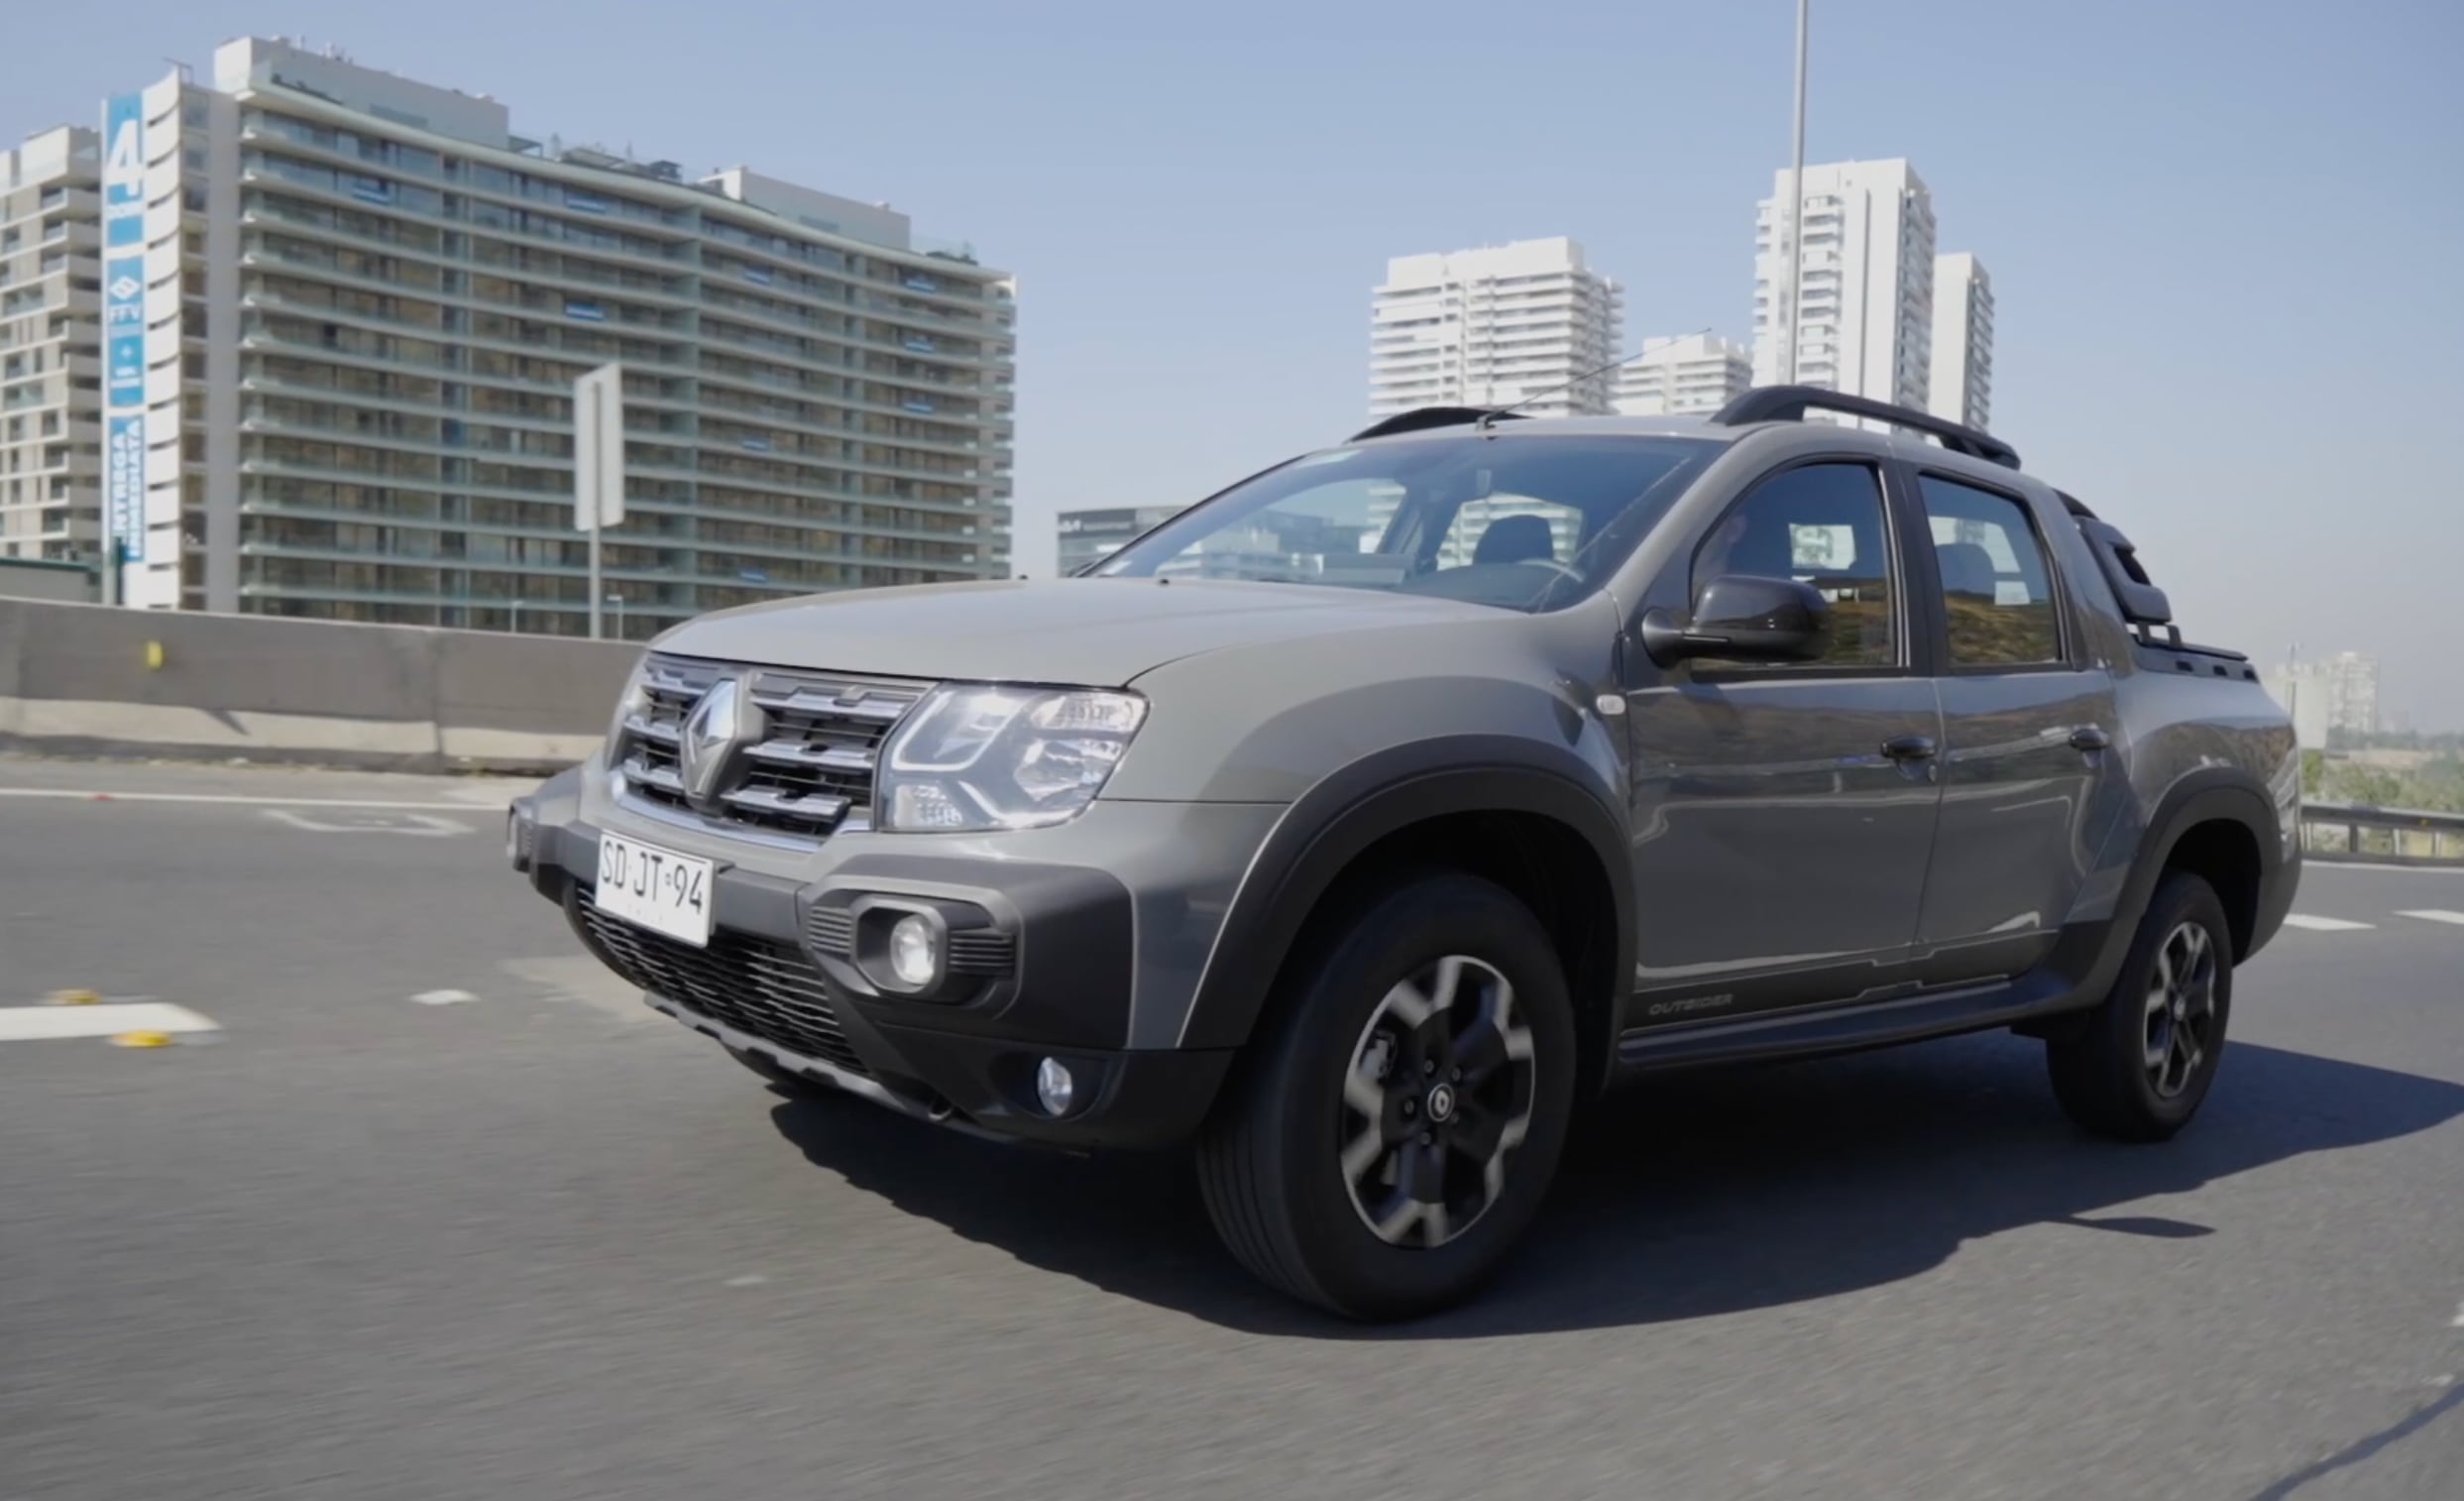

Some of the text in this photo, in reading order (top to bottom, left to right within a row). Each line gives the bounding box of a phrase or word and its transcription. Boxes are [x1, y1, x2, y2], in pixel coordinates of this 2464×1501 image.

[105, 119, 143, 196] 4
[127, 418, 141, 557] INMEDIATA
[1647, 992, 1735, 1016] OUTSIDER
